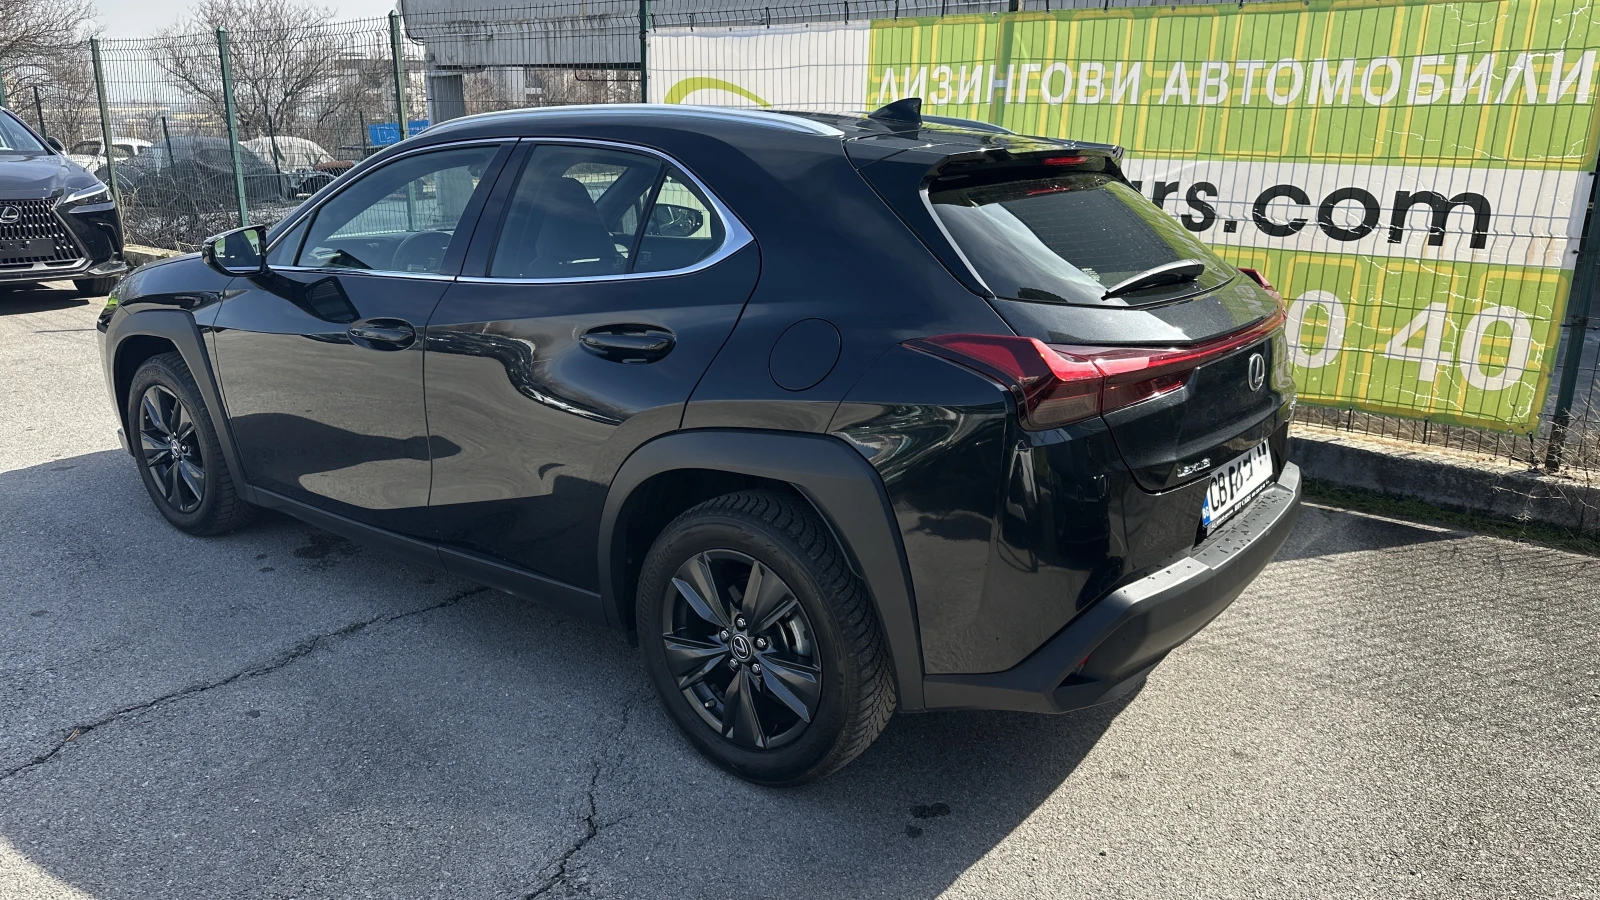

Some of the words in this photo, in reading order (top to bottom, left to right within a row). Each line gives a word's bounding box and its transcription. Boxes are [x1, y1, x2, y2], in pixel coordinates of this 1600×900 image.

[877, 61, 1143, 105] ЛИЗИНГОВИ
[1158, 50, 1597, 105] АВТОМОБИЛИ
[1384, 301, 1532, 391] 40
[1177, 458, 1211, 477] LEXUS
